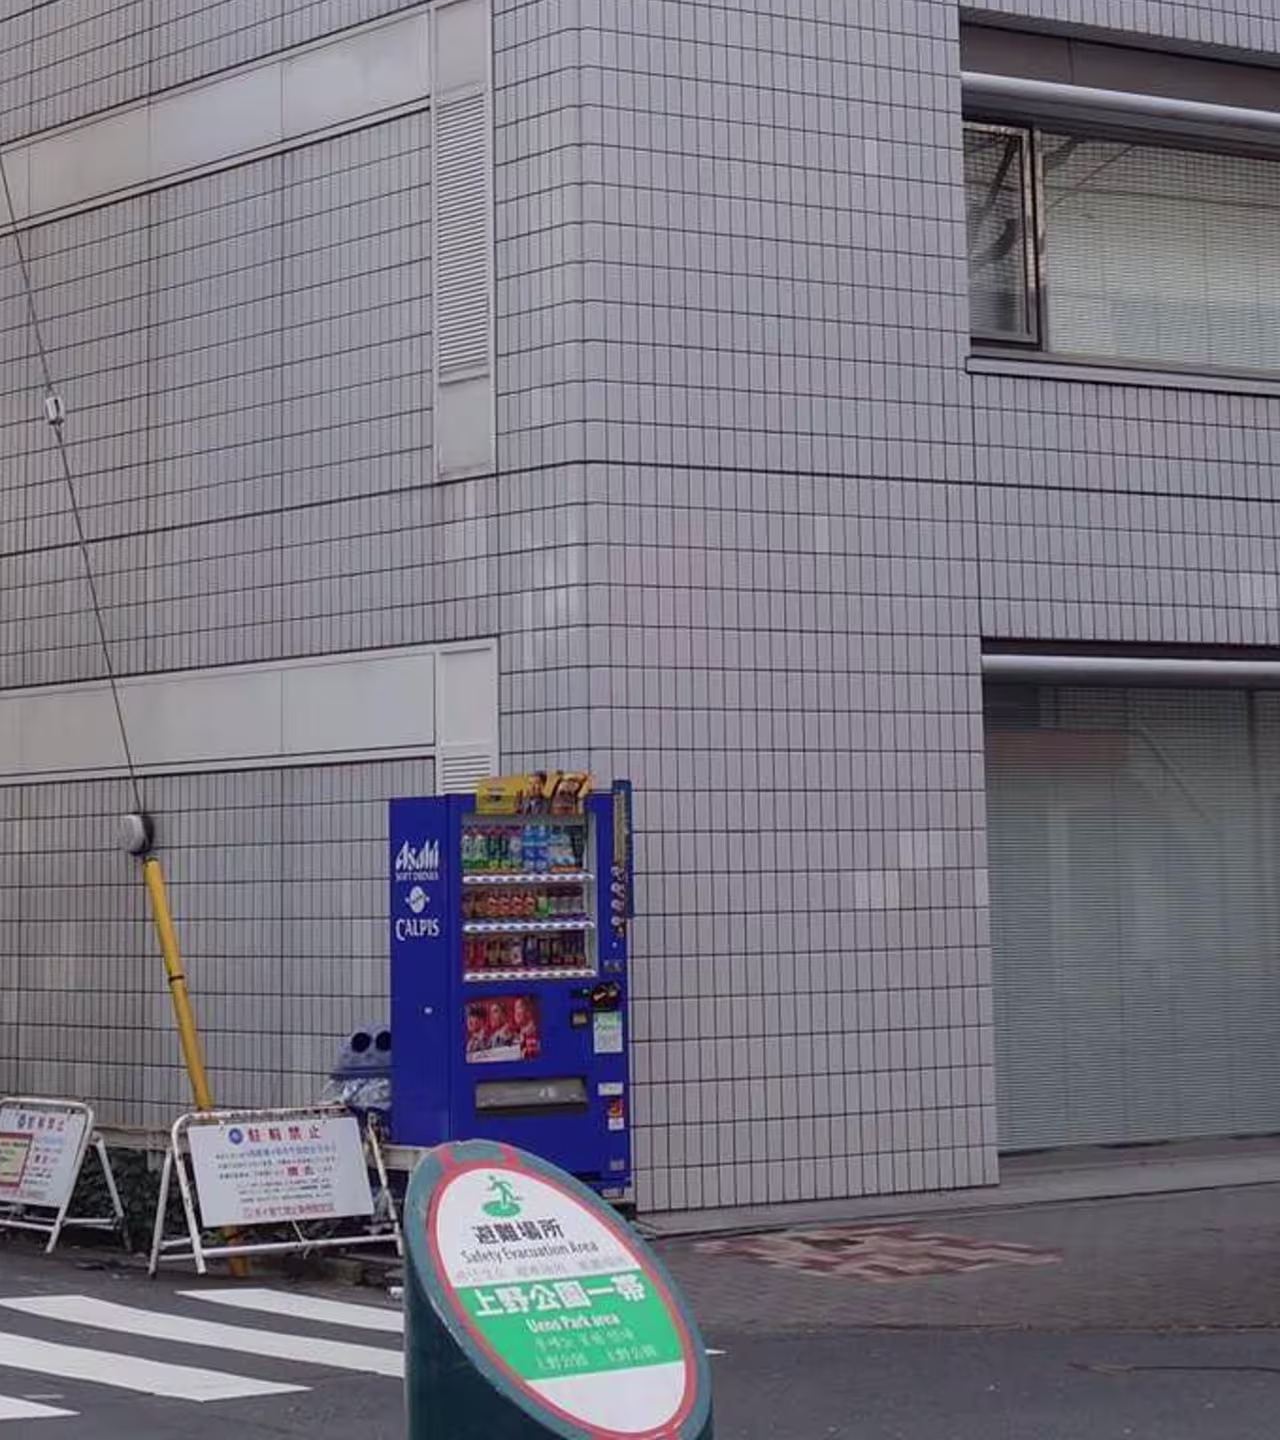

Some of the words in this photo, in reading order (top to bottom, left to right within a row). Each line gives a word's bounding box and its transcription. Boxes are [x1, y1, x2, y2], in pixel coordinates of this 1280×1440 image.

[395, 840, 440, 871] Asahi
[395, 918, 440, 941] CALPIS
[472, 1218, 565, 1245] 避難場所
[461, 1247, 503, 1264] Safety
[504, 1243, 570, 1261] Evacuation
[570, 1240, 599, 1254] Area
[474, 1273, 646, 1317] 上野公園一帯
